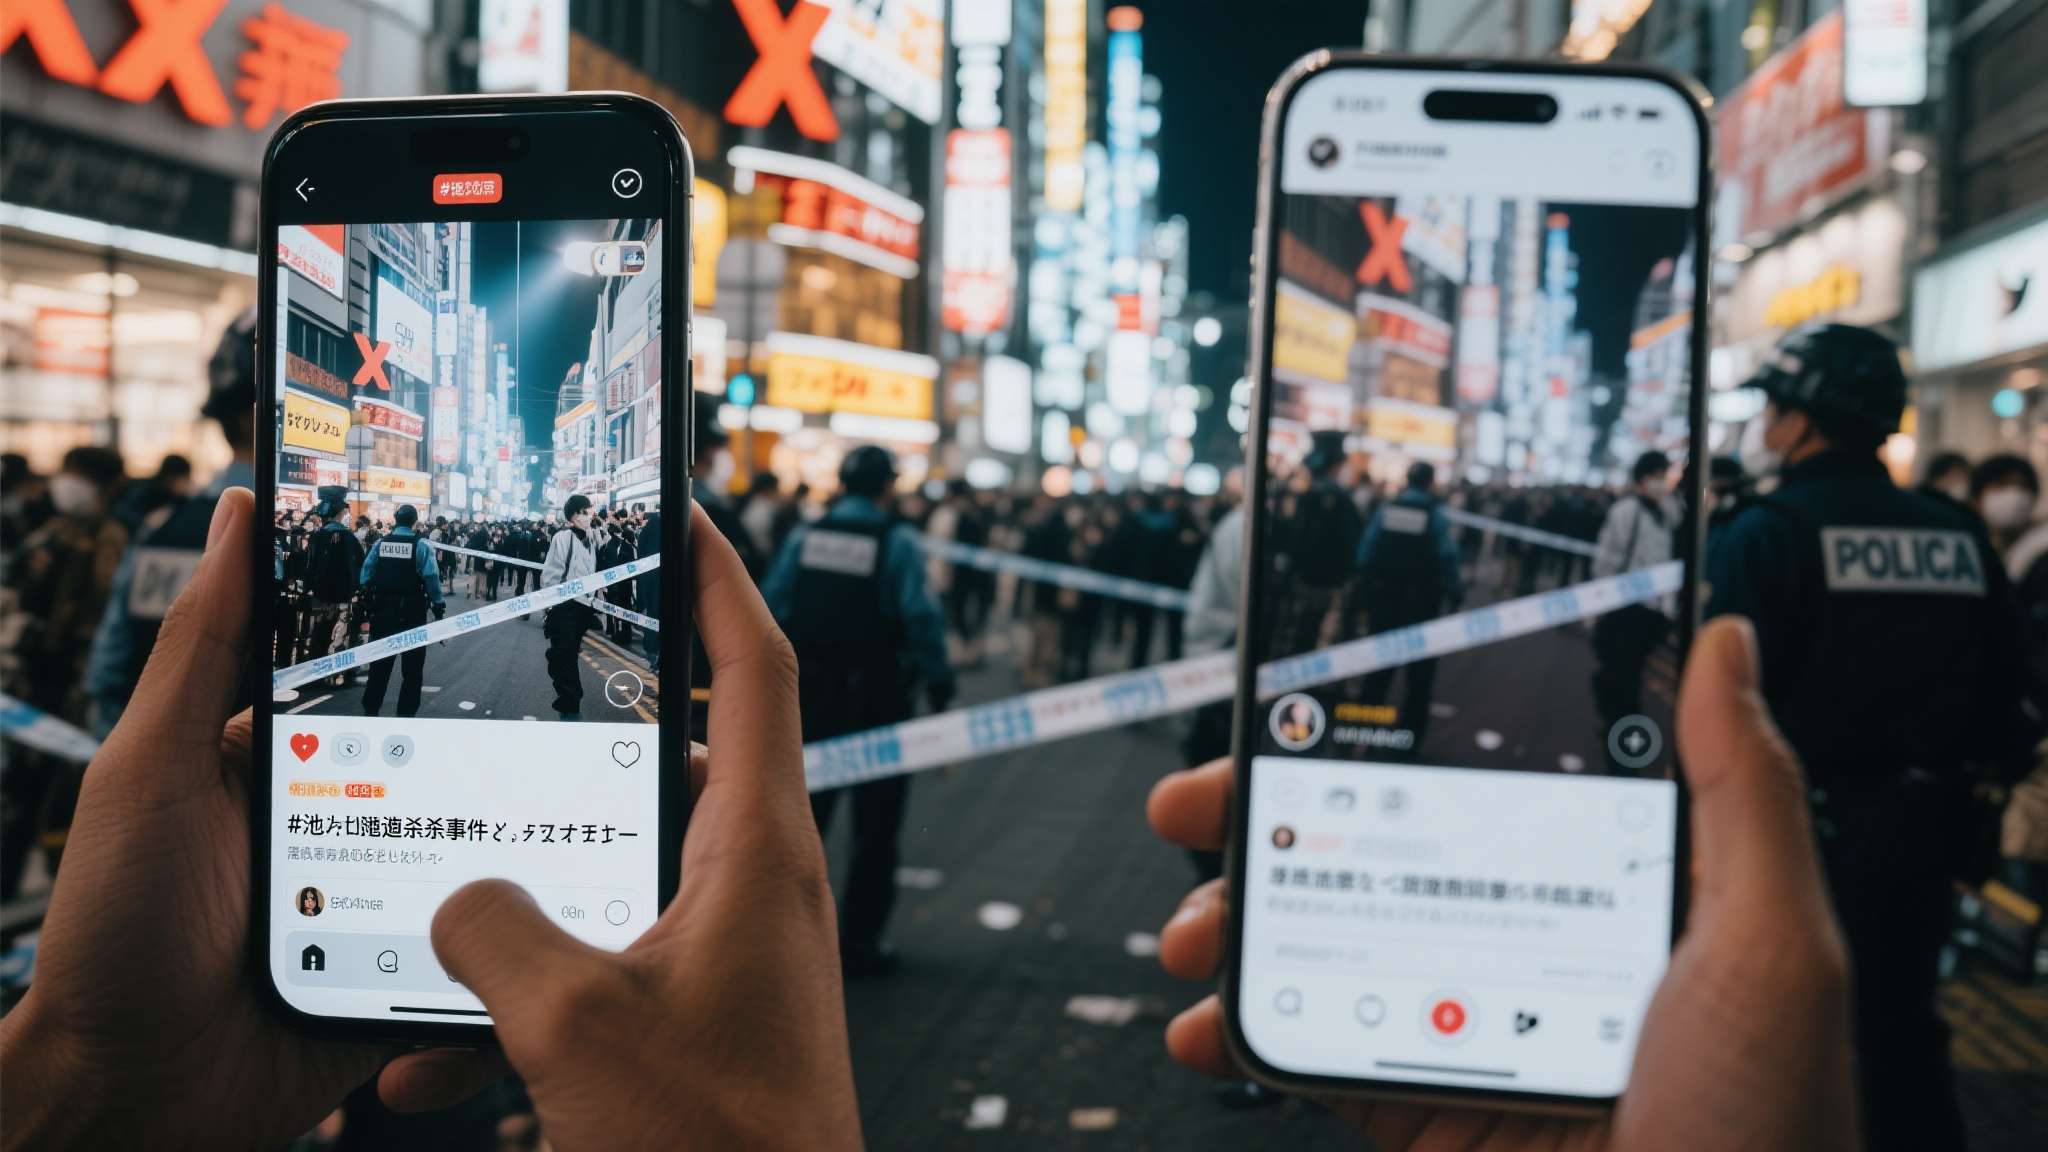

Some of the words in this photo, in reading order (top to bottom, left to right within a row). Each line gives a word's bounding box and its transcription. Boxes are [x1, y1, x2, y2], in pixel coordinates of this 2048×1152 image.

[723, 0, 840, 142] X
[1355, 201, 1413, 293] X
[352, 331, 392, 391] X
[1836, 538, 1980, 581] POLICA
